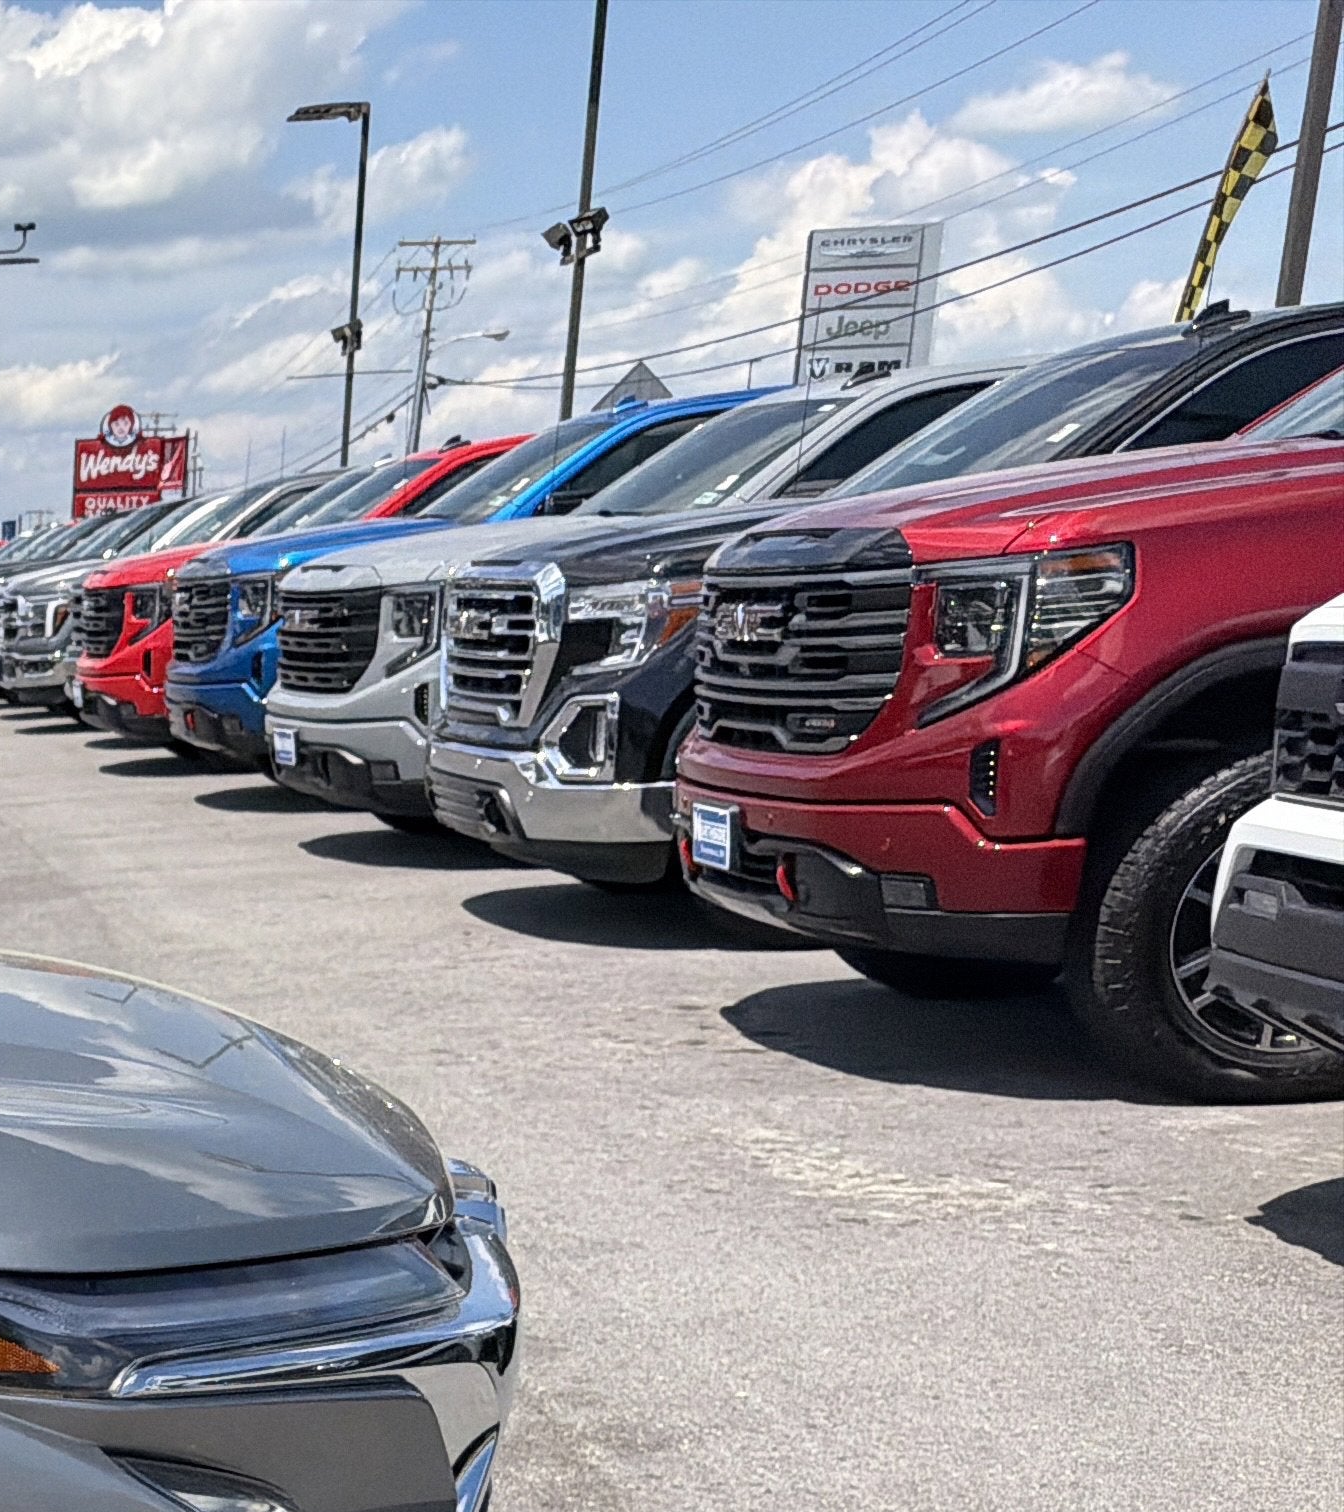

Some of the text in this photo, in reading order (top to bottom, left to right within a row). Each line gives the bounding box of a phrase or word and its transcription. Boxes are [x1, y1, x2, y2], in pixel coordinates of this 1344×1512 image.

[819, 235, 913, 247] CHRYSLER
[813, 280, 911, 296] DODGE
[825, 315, 891, 340] Jeep
[79, 445, 160, 482] Wendy's
[84, 495, 150, 511] QUALITY
